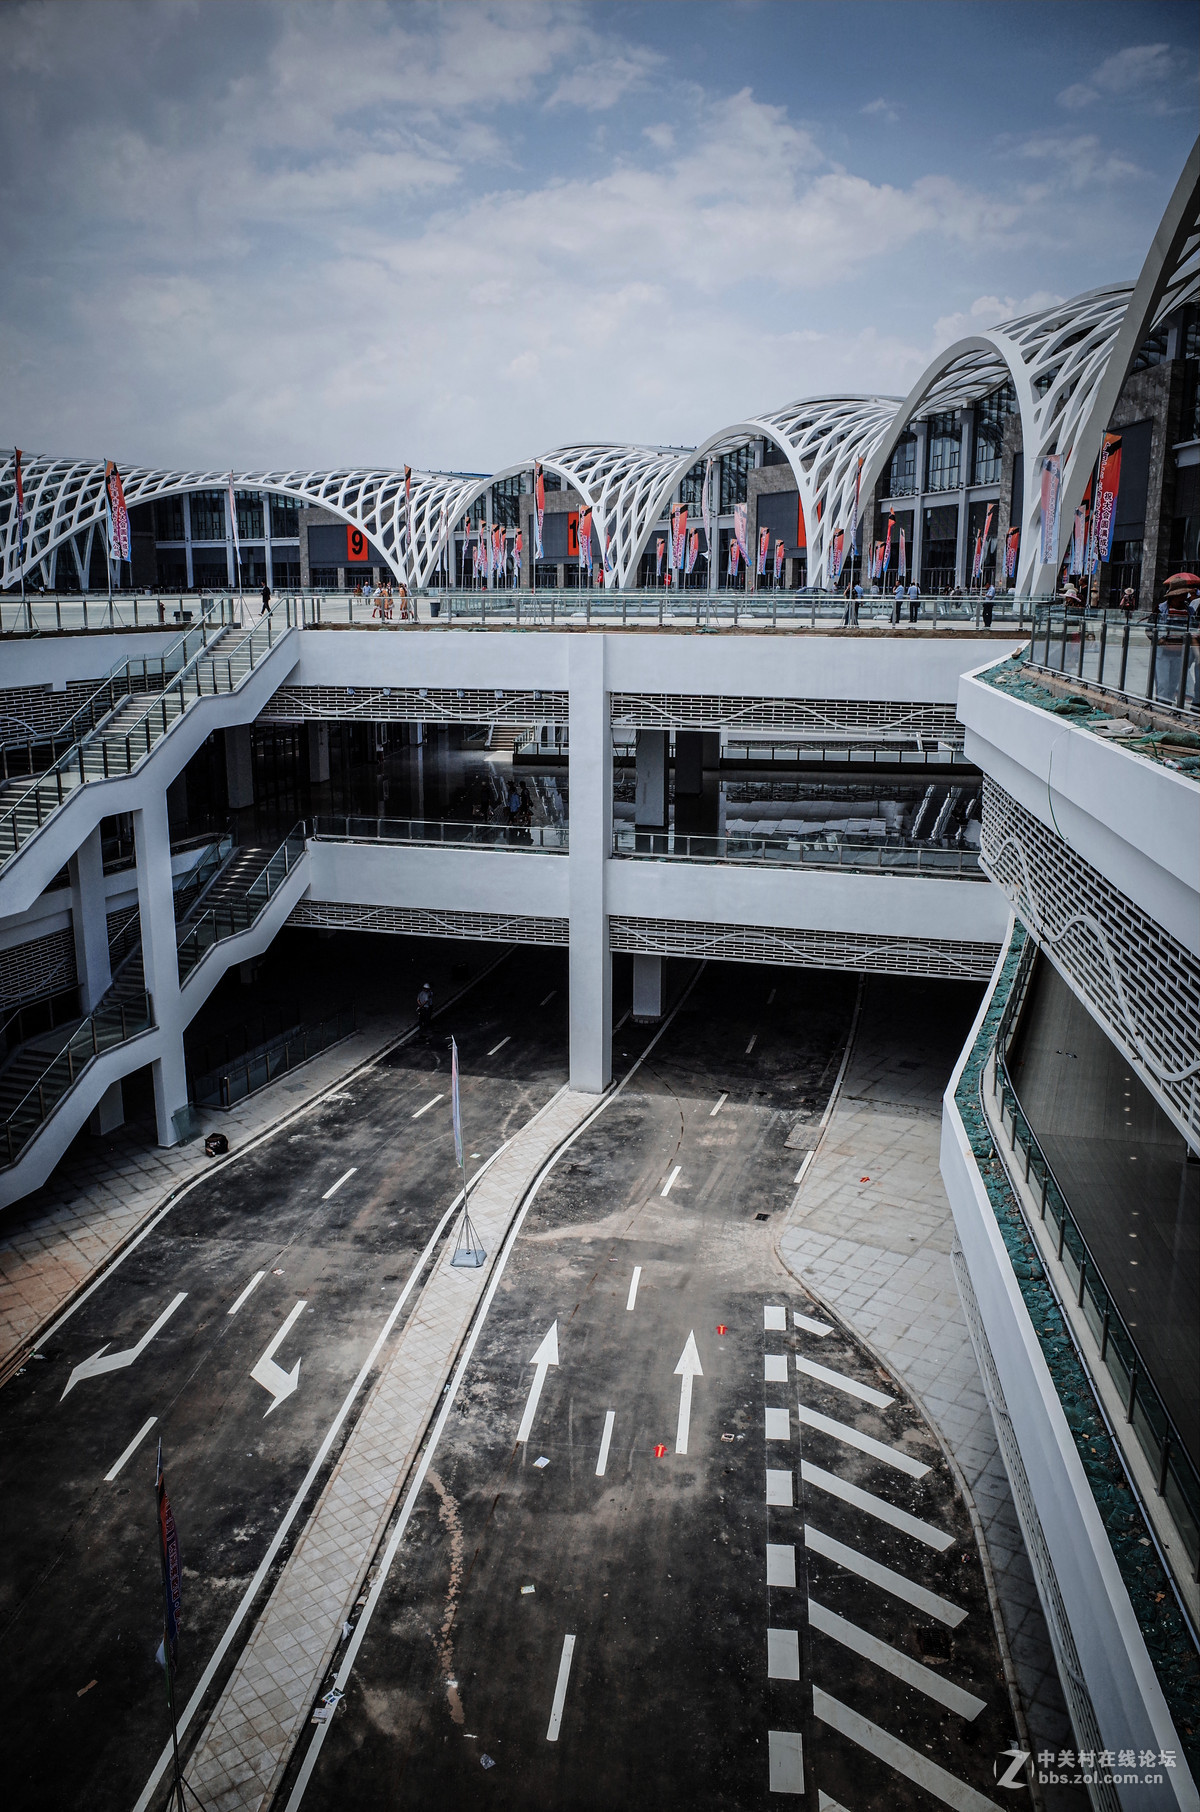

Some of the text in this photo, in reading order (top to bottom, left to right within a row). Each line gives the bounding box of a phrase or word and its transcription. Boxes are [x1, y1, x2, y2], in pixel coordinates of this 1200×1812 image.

[352, 530, 363, 555] 9
[1100, 491, 1113, 556] 祝大会圆满成功
